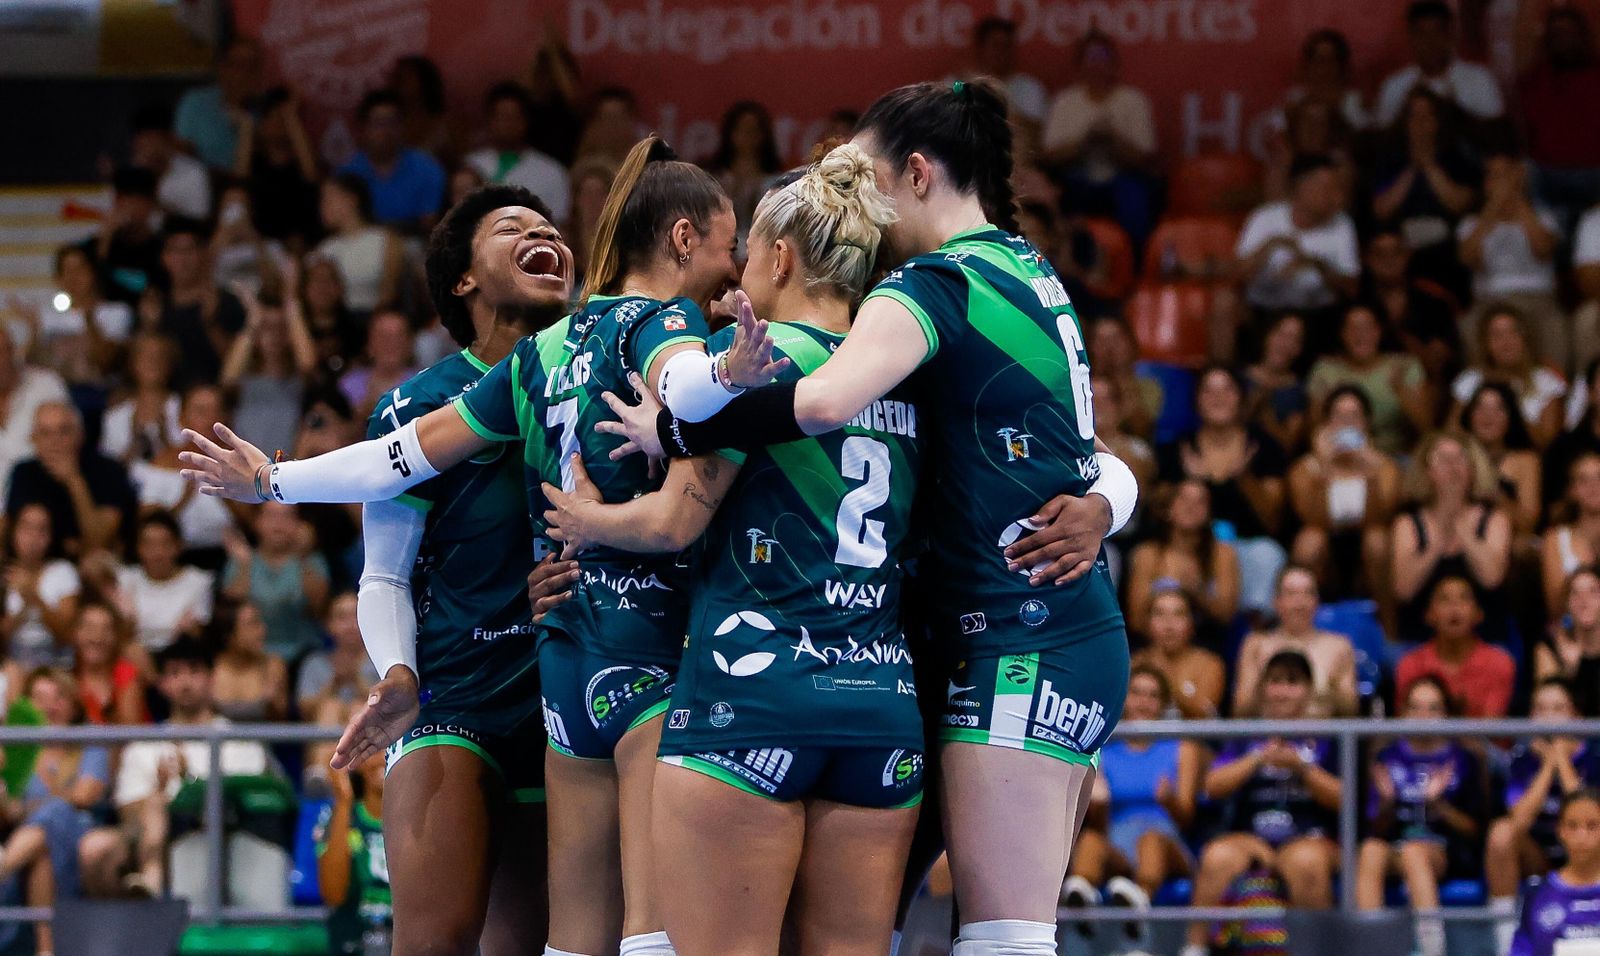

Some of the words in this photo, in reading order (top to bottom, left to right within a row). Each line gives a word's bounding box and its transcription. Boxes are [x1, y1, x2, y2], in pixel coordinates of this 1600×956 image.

[567, 0, 880, 63] Delegación
[901, 0, 972, 48] de
[1056, 313, 1095, 441] 6
[388, 440, 412, 478] SP
[546, 397, 581, 493] 7
[834, 436, 892, 568] 2
[824, 579, 887, 609] WAY
[790, 625, 914, 665] Andalucí
[1035, 679, 1106, 750] berlin
